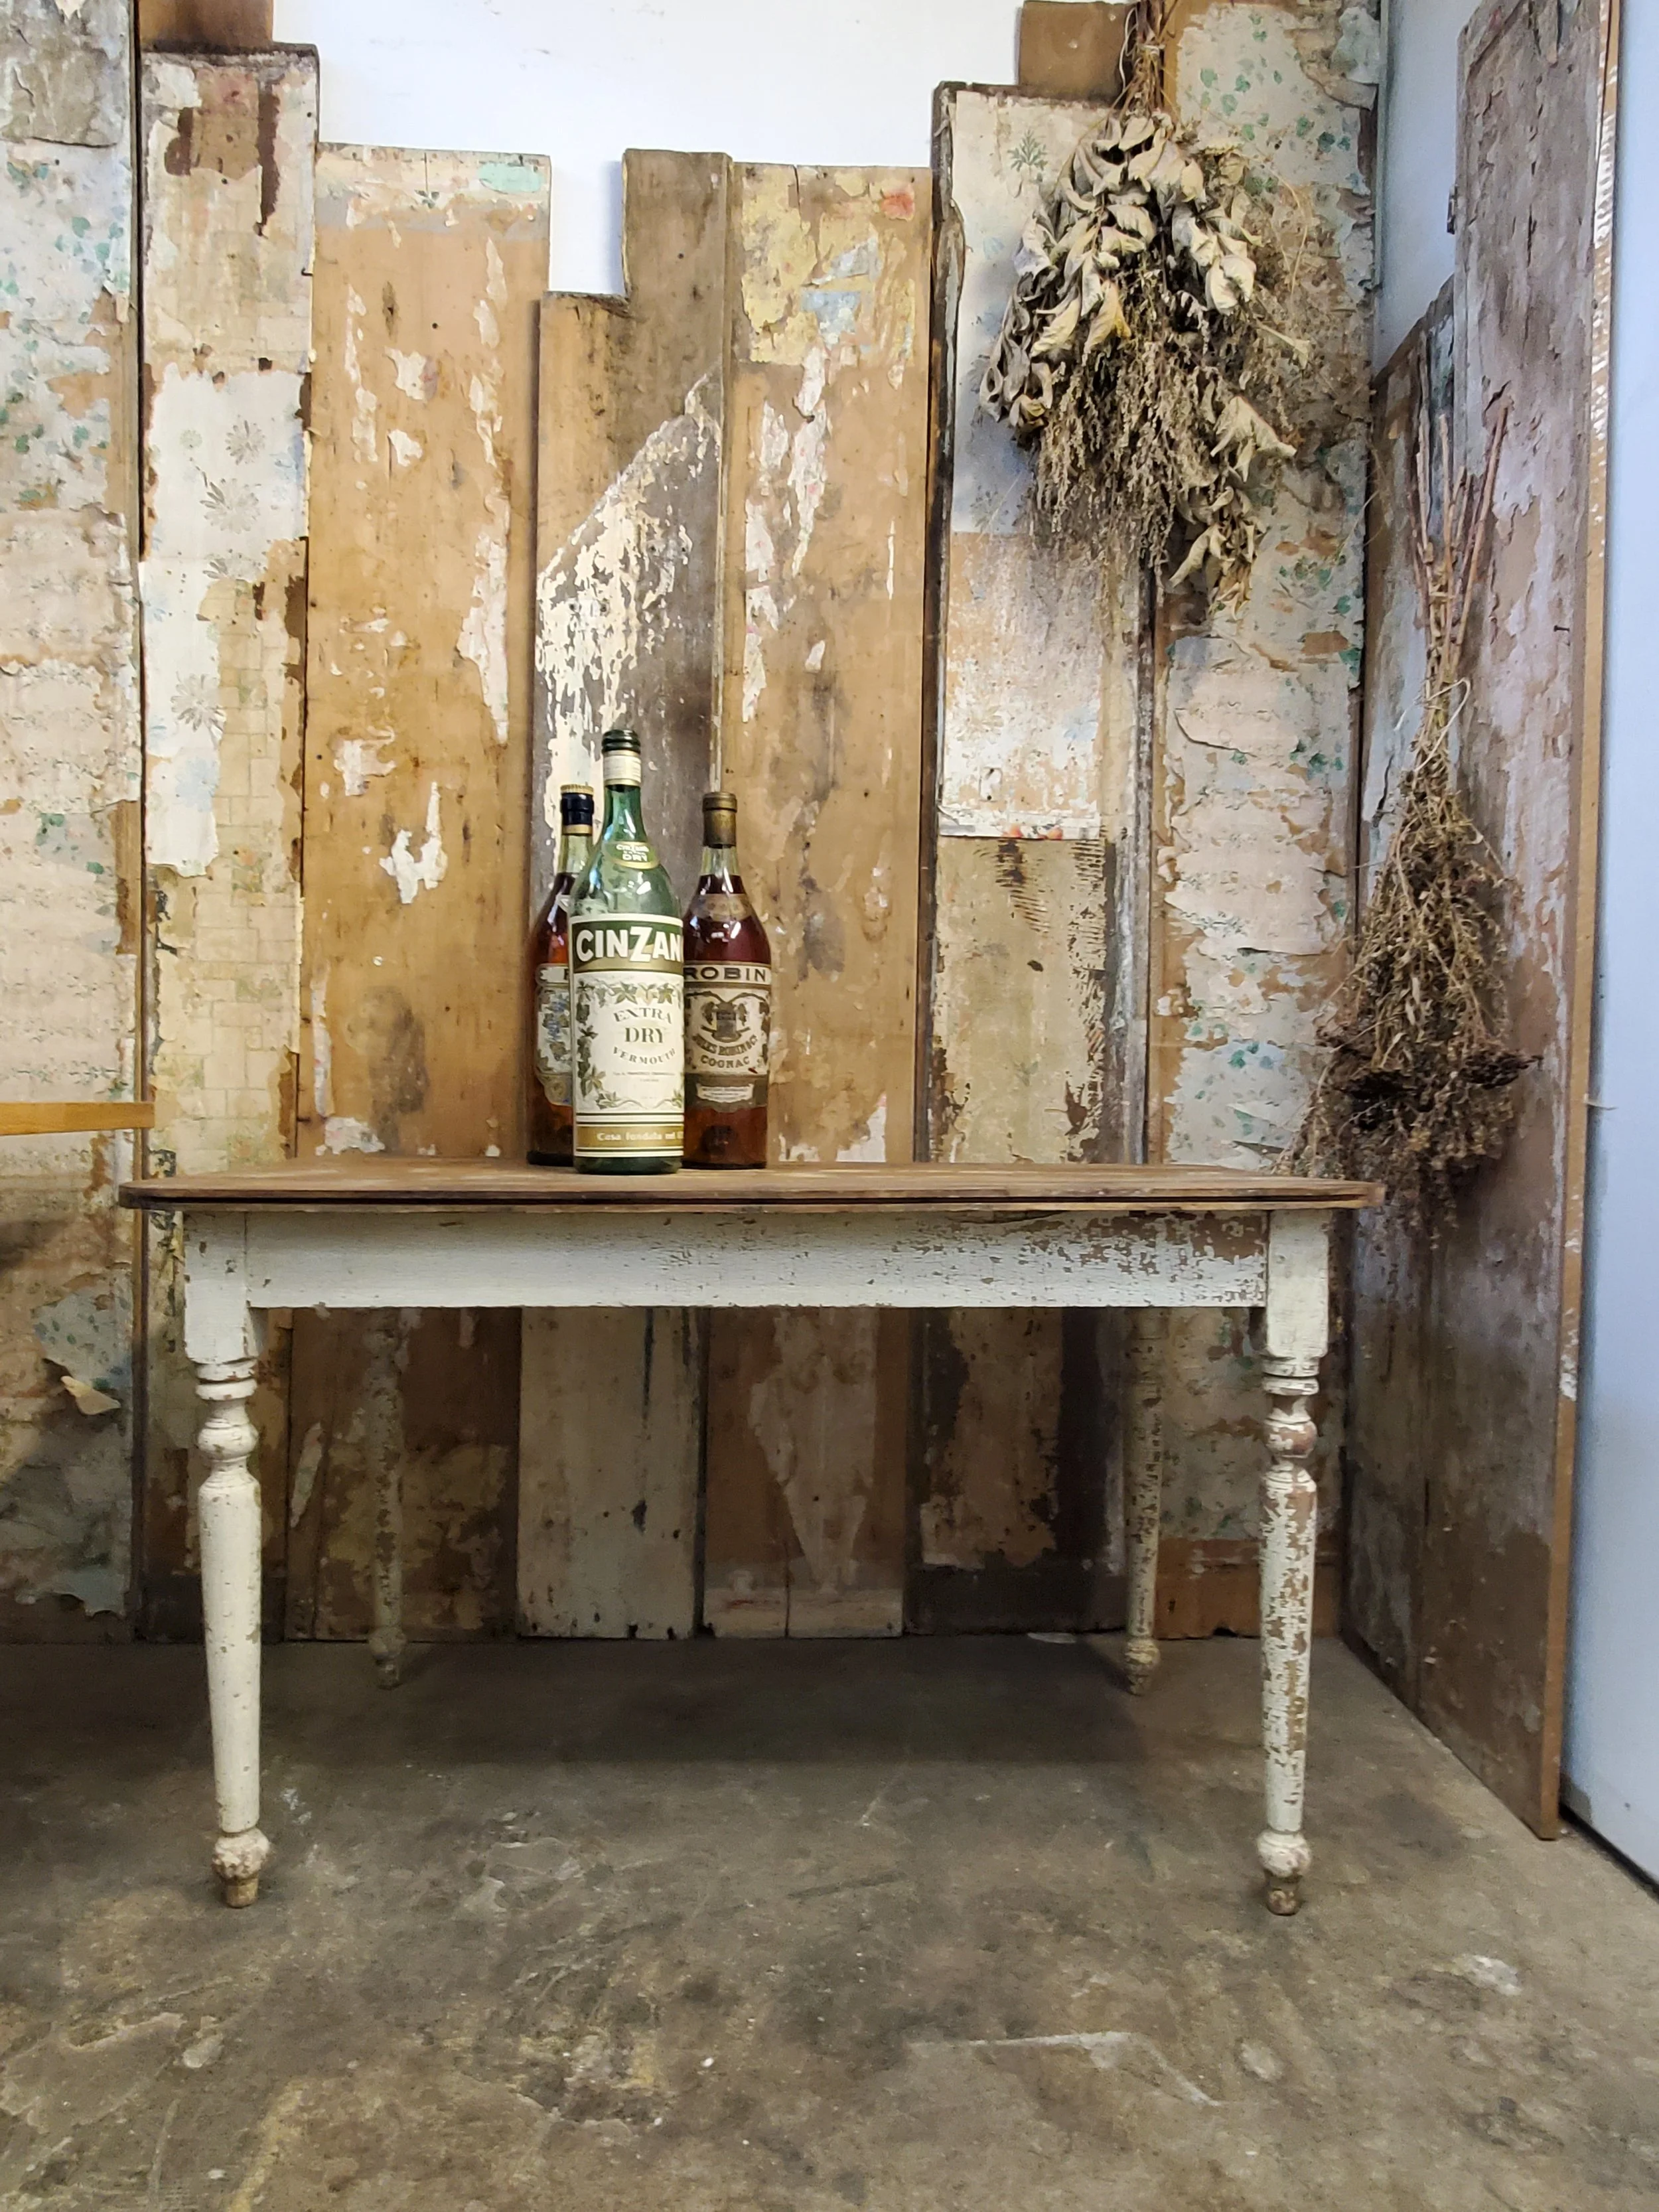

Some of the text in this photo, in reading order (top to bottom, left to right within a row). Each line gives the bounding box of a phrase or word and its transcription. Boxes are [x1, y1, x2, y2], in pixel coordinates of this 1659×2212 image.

[622, 853, 648, 862] DRY
[576, 926, 684, 963] CINZAN
[683, 966, 766, 982] ROBIN
[613, 1007, 672, 1025] EXTRA
[624, 1027, 664, 1044] DRY
[613, 1046, 676, 1065] VERMOUTH
[700, 1054, 750, 1069] COGNAC
